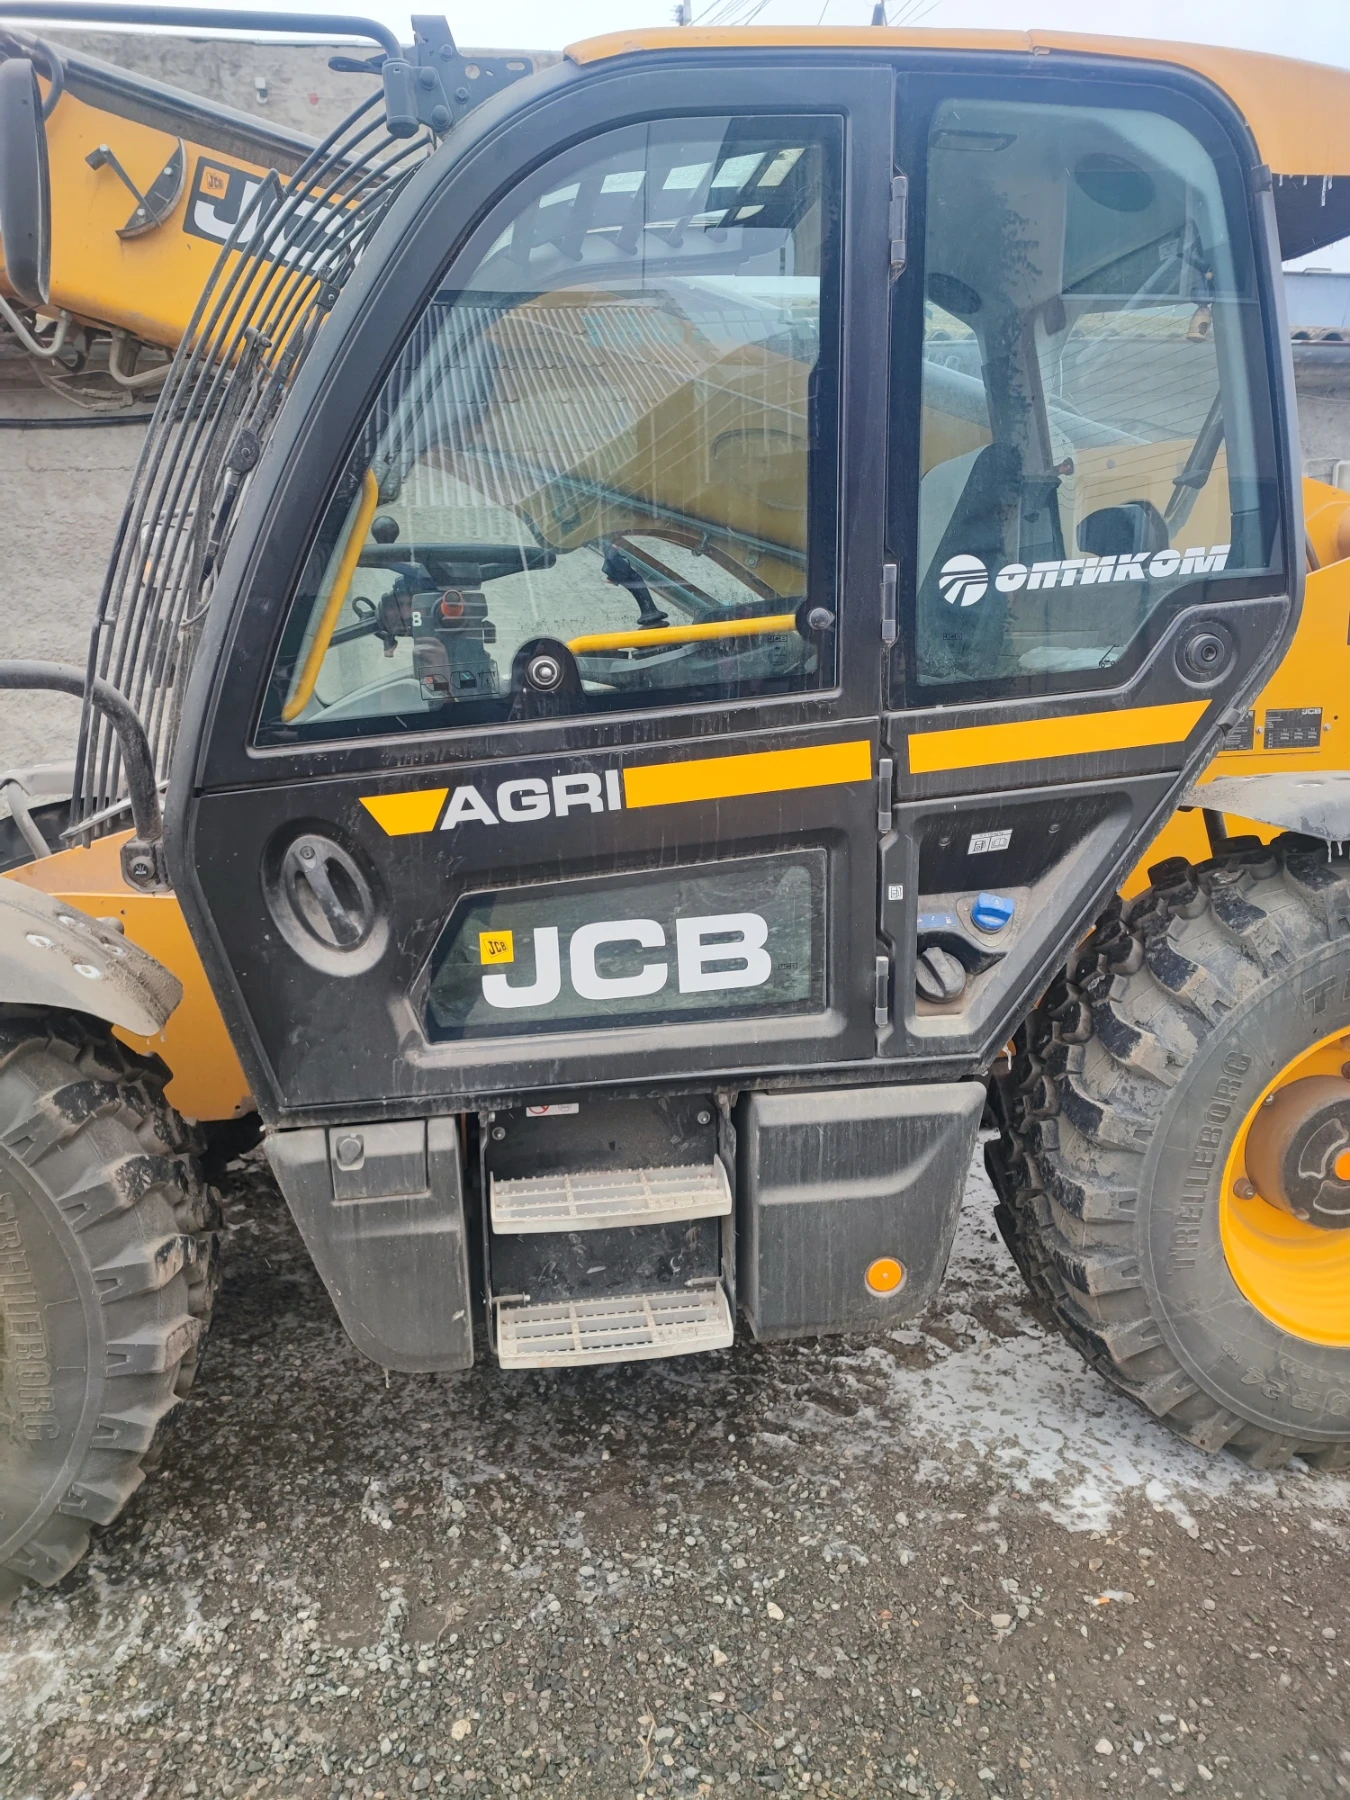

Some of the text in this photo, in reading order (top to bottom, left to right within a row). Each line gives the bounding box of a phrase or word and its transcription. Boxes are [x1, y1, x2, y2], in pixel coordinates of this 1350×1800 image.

[194, 180, 366, 272] JC
[994, 545, 1231, 592] ОПТИКОМ
[440, 769, 621, 830] AGRI
[482, 913, 772, 1008] JCB
[488, 940, 507, 955] JCB
[1172, 1050, 1252, 1271] TRELLEBORG
